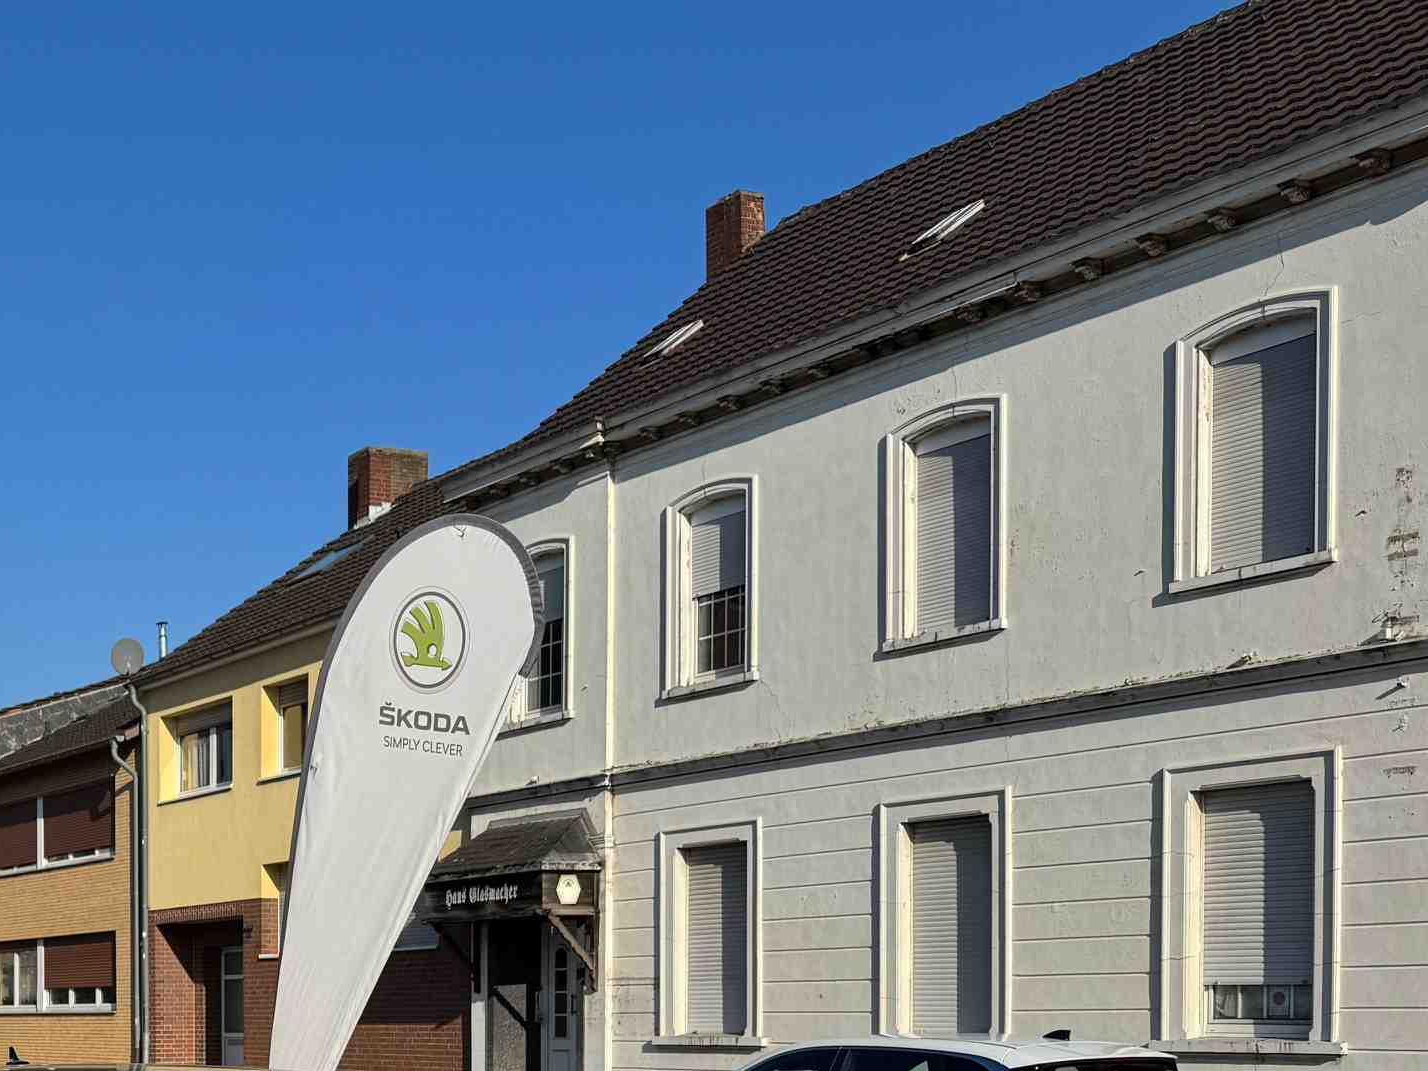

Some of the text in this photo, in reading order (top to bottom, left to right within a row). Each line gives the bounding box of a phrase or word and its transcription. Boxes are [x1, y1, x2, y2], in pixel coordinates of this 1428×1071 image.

[379, 701, 470, 735] ŠKODA
[383, 735, 463, 756] SIMPLY CLEVER
